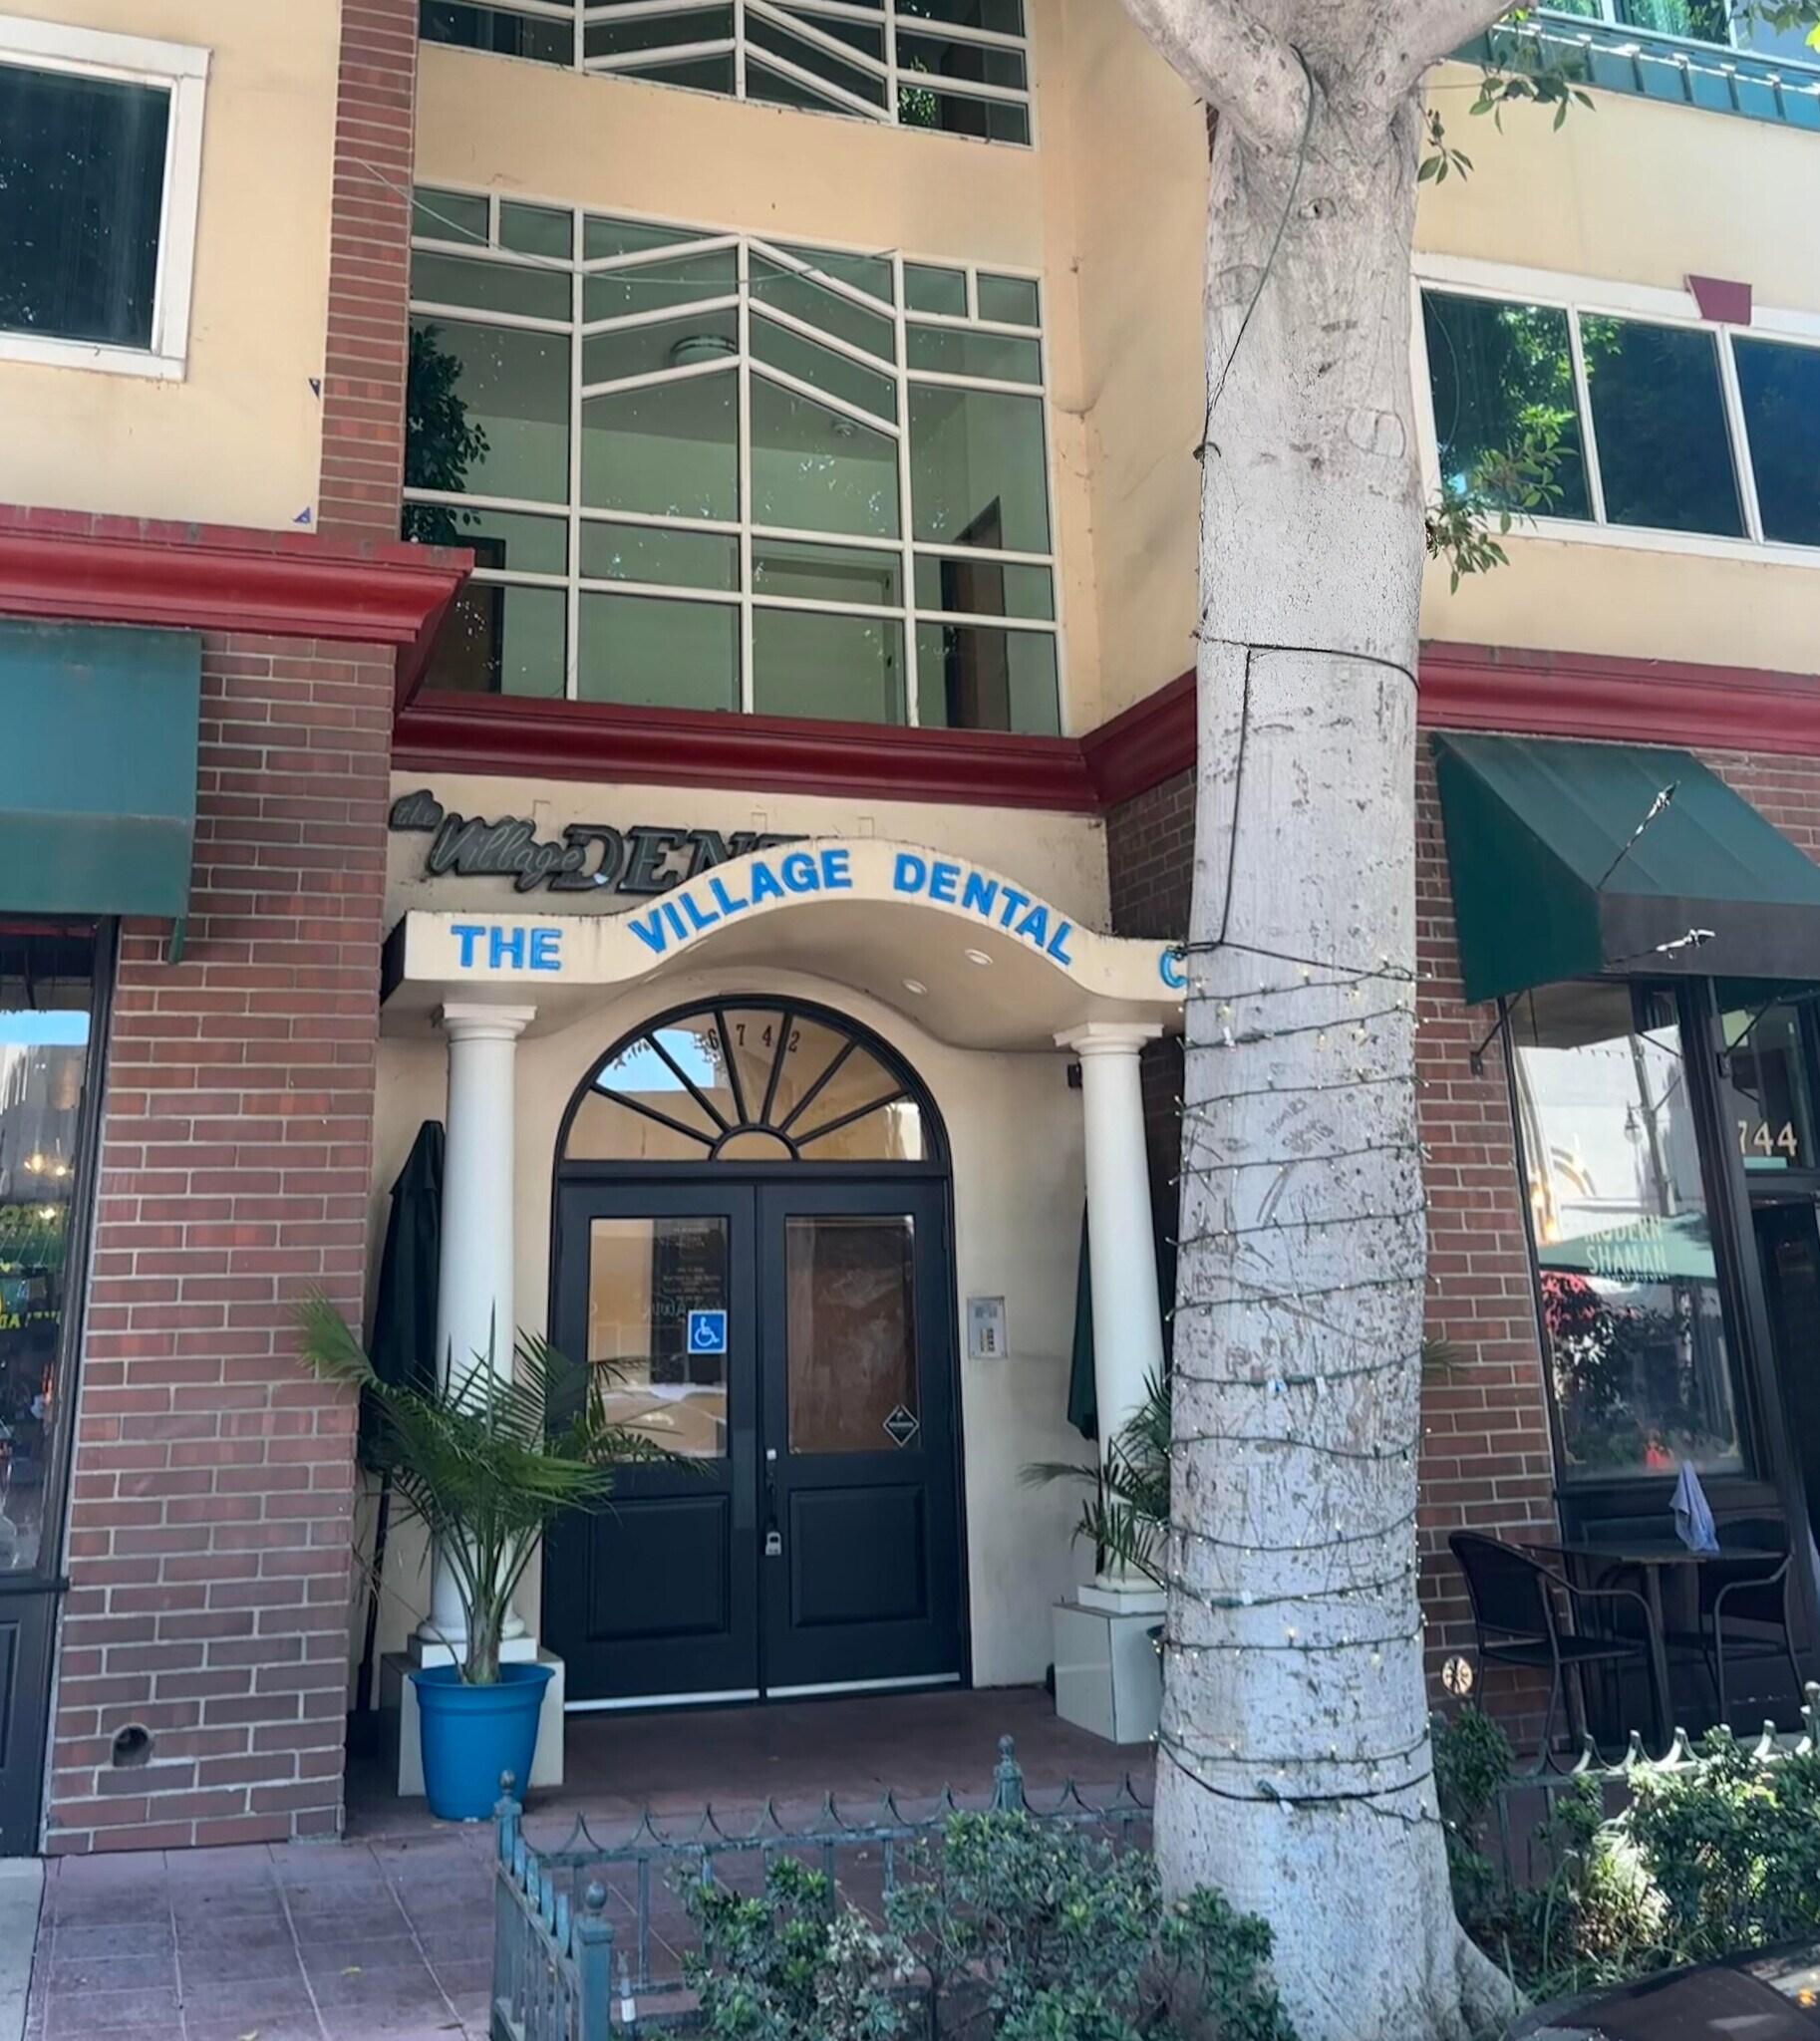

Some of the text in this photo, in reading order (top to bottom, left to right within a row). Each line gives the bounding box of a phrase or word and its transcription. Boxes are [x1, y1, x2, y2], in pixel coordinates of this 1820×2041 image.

[391, 791, 810, 894] the Village DEN
[451, 925, 563, 970] THE
[627, 849, 852, 953] VILLAGE
[893, 853, 1072, 965] DENTAL
[1586, 1244, 1668, 1275] SHAMAN
